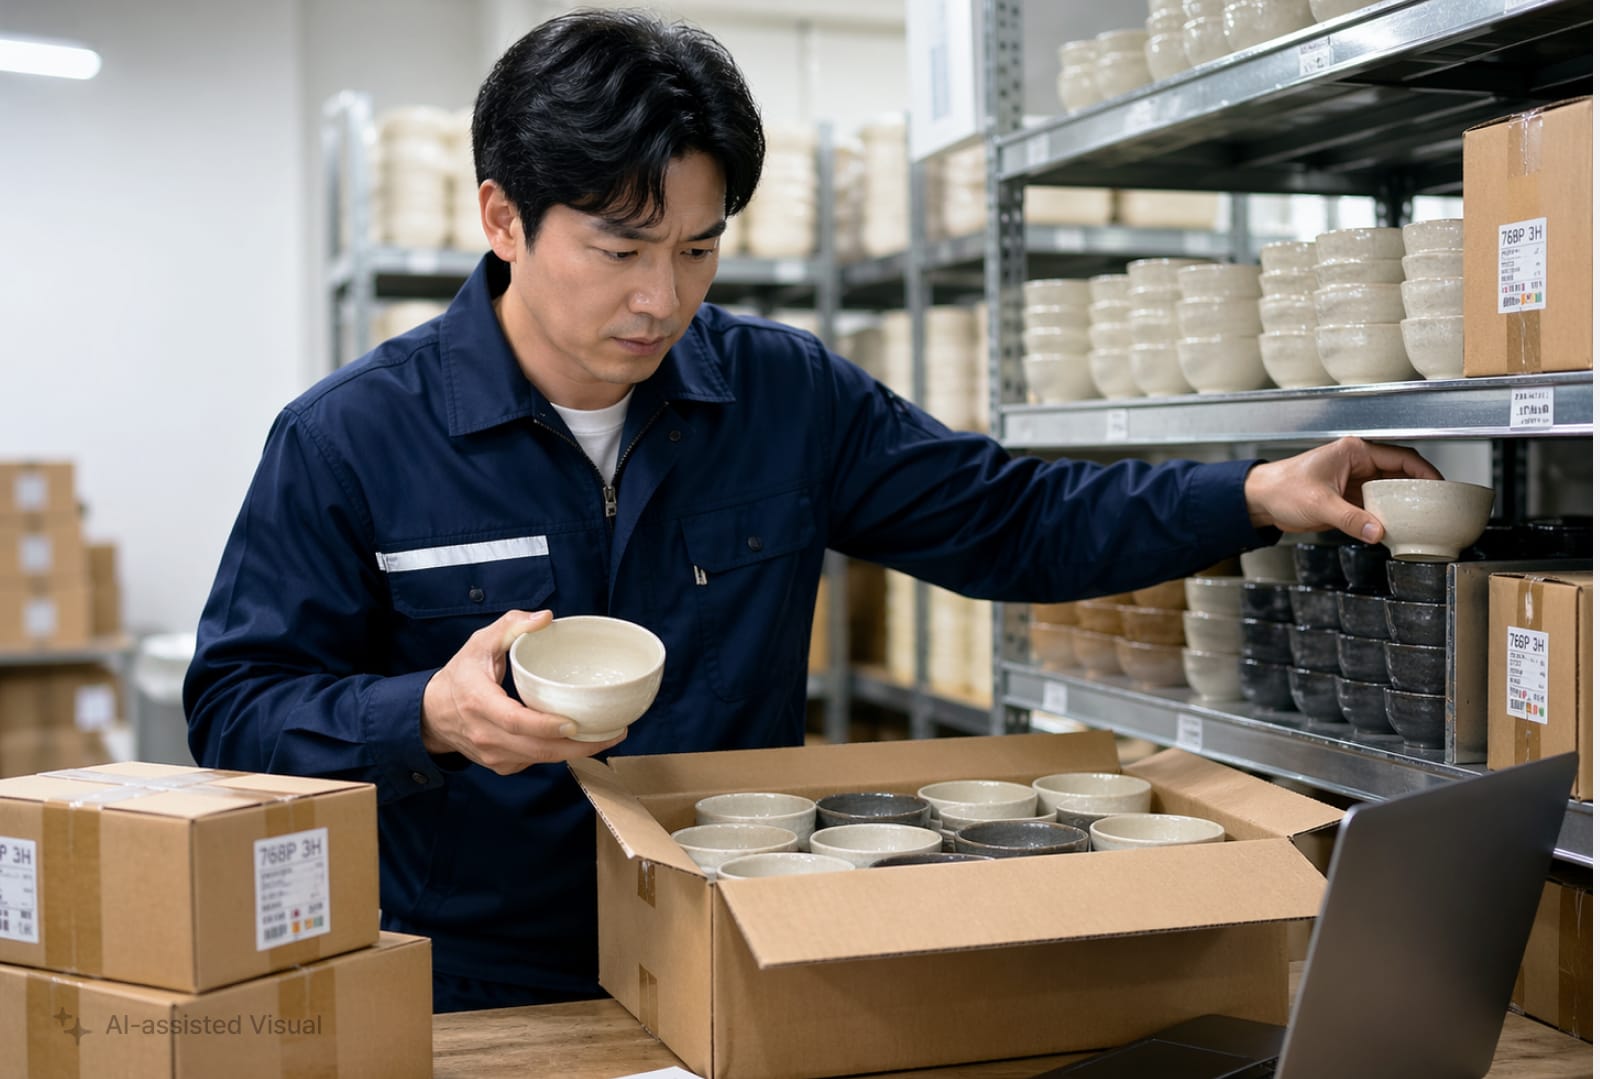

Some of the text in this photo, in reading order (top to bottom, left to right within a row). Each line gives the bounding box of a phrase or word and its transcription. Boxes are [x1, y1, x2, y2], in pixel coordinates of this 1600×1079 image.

[1528, 225, 1543, 241] 3H
[1533, 637, 1545, 653] 3H
[13, 846, 31, 864] 3H
[259, 838, 322, 866] 768P 3H
